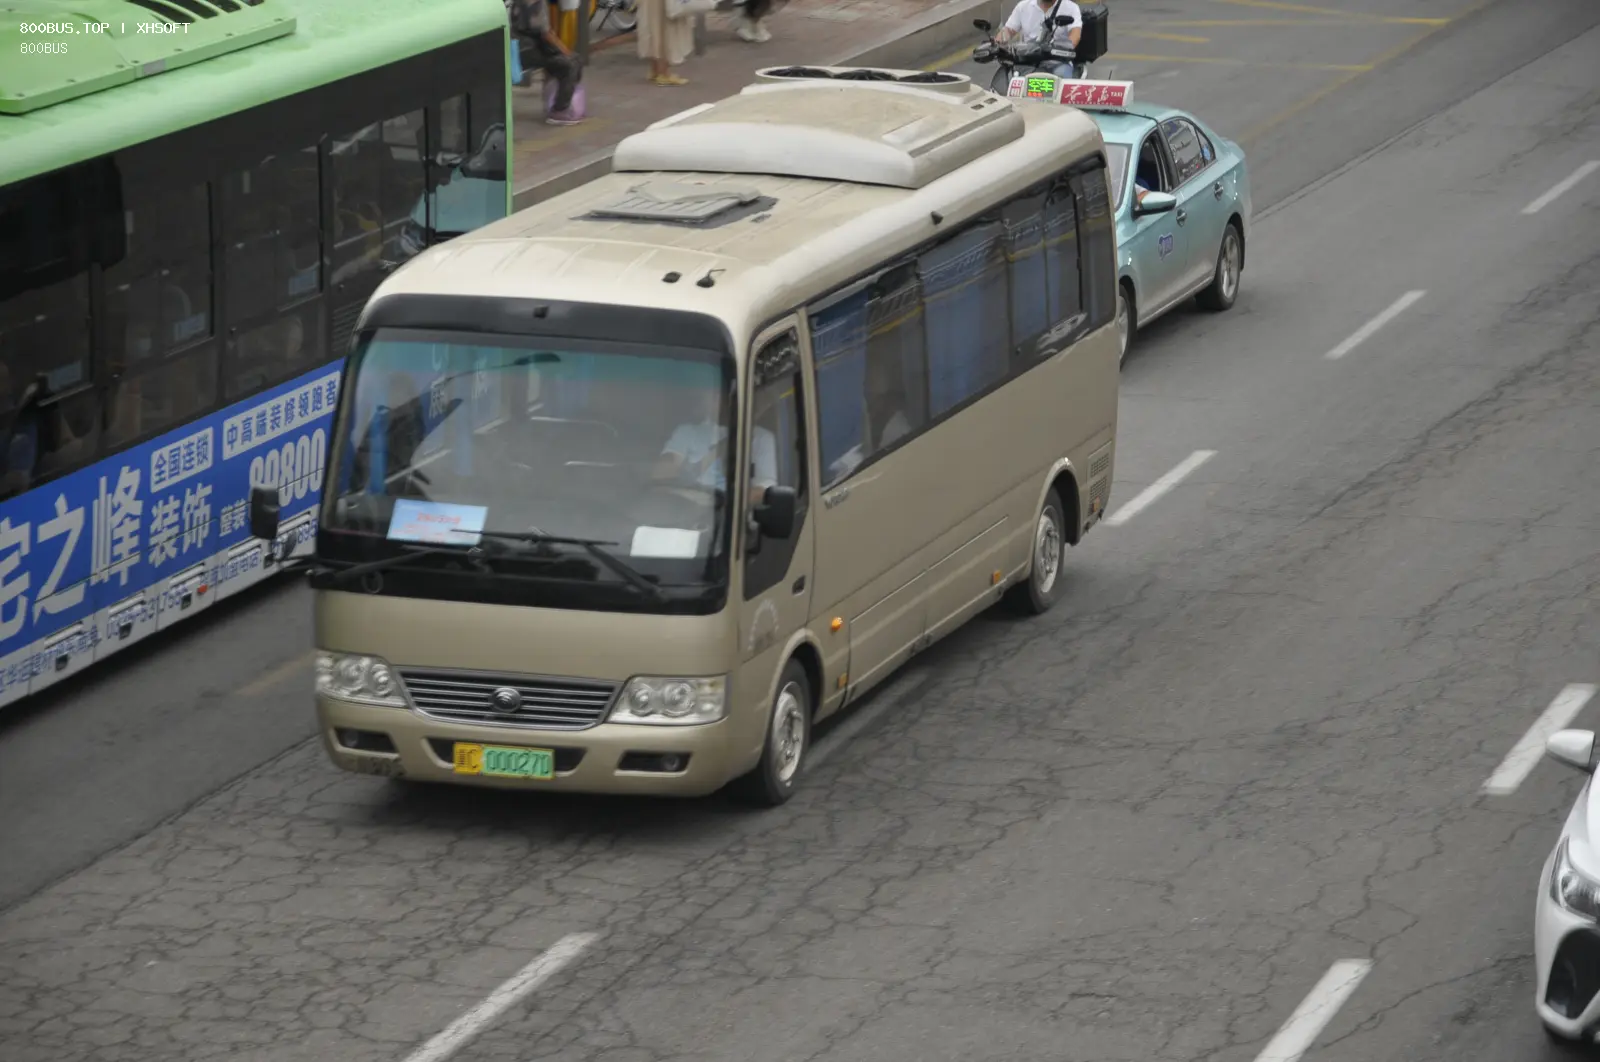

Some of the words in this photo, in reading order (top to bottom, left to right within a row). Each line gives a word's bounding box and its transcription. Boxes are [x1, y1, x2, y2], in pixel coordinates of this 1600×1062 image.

[1028, 78, 1056, 93] 空车
[153, 432, 210, 486] 全国连锁
[147, 481, 213, 568] 装饰
